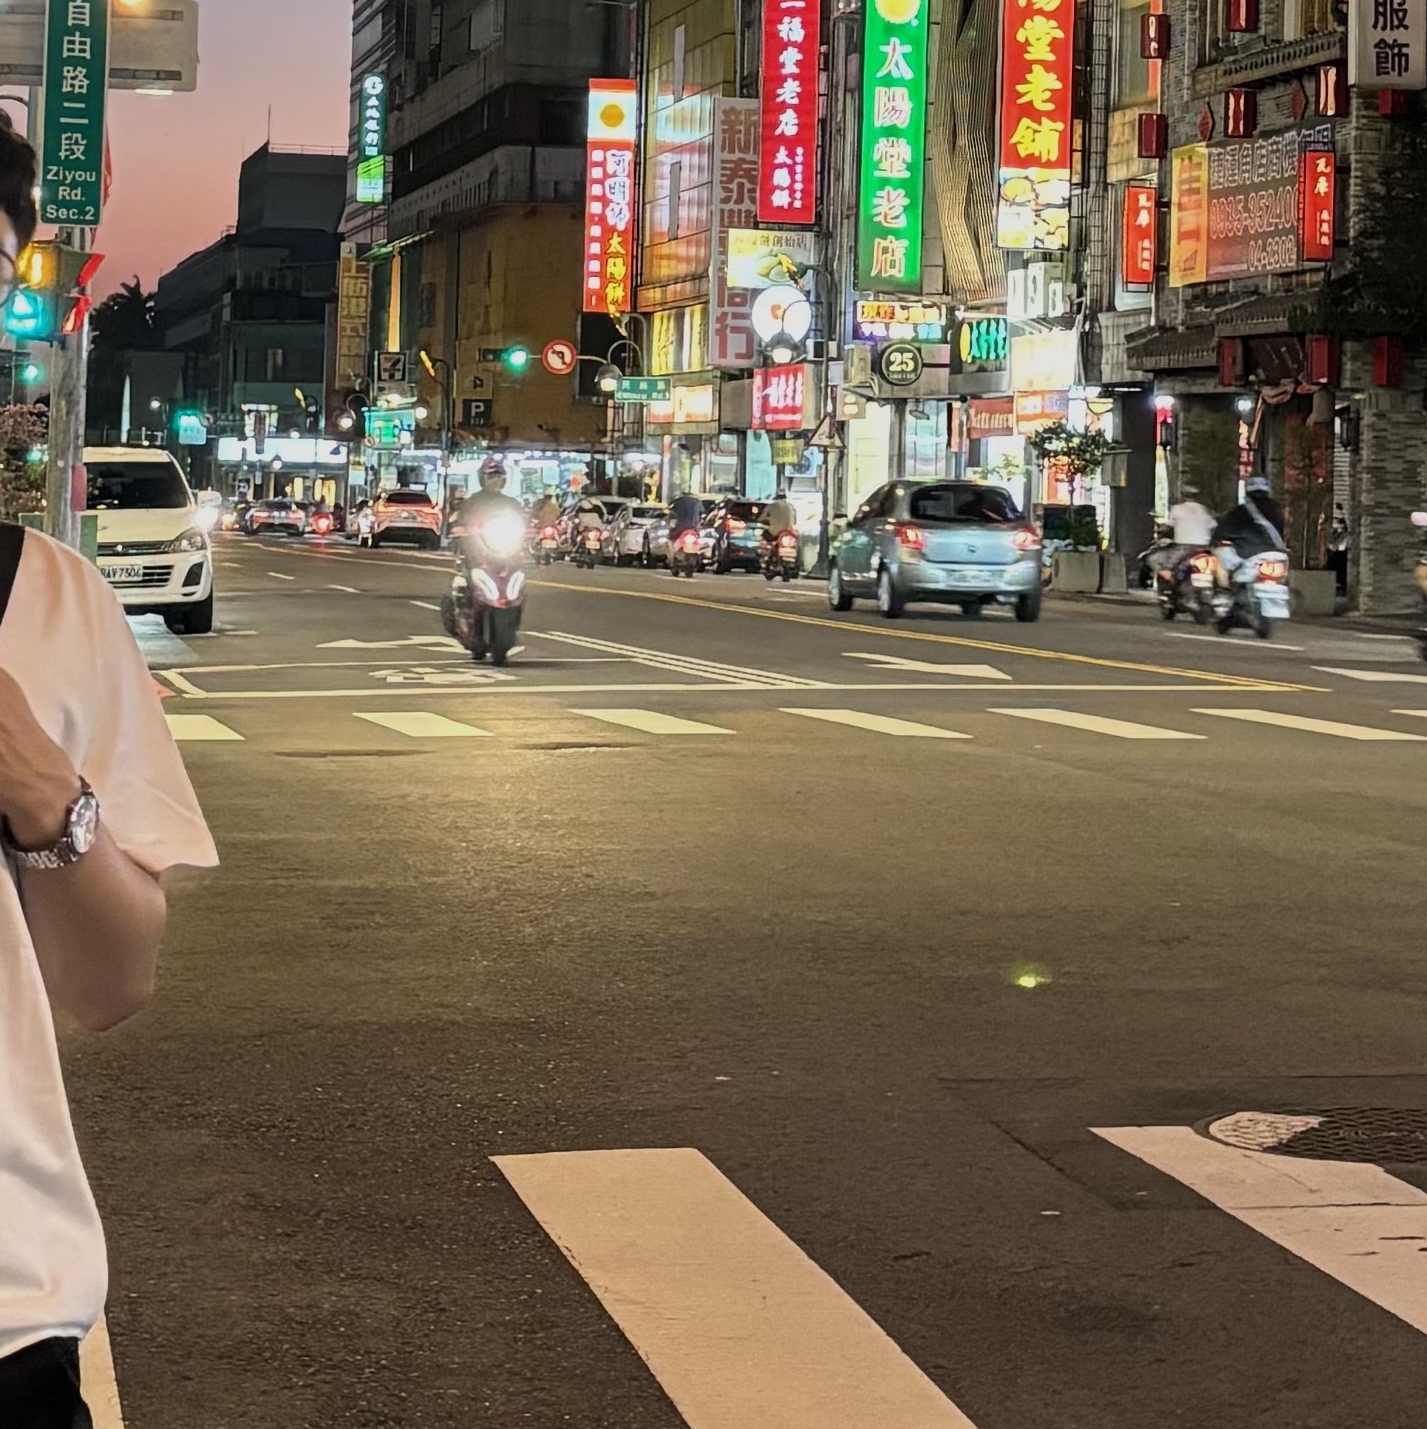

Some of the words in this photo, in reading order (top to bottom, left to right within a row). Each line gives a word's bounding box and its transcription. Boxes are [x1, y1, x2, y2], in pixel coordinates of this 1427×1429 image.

[869, 36, 916, 278] 太陽堂老店
[46, 166, 96, 184] Ziyou
[58, 187, 86, 202] Rd.
[45, 204, 95, 220] Sec.2
[888, 351, 916, 372] 25
